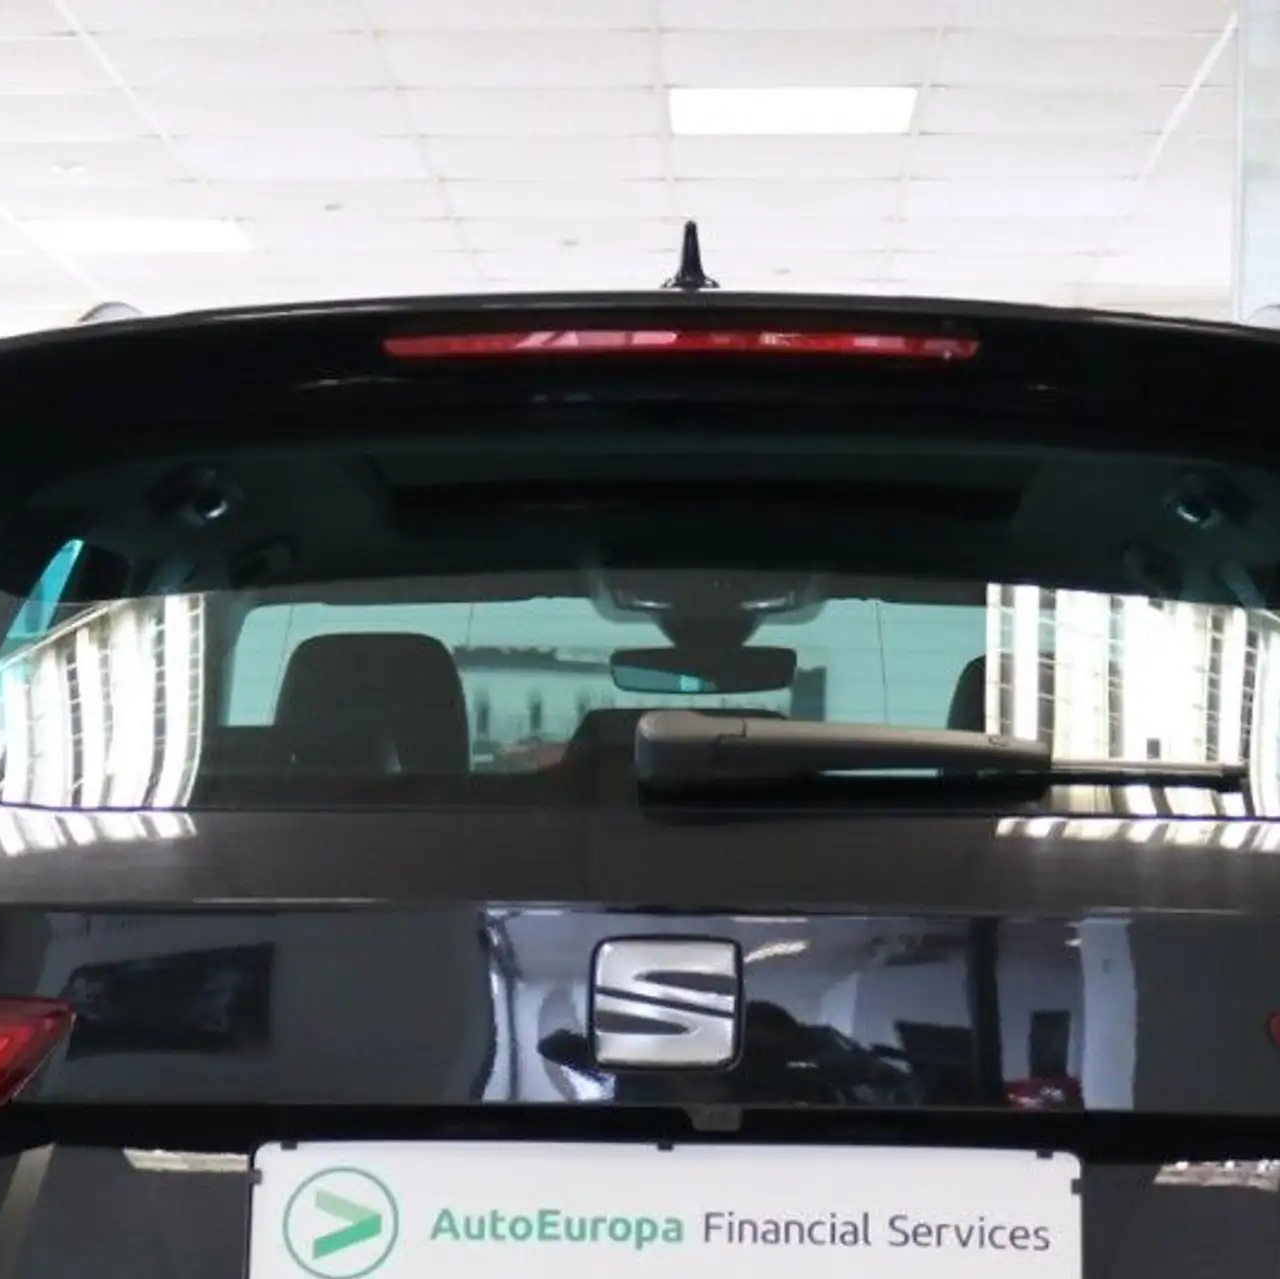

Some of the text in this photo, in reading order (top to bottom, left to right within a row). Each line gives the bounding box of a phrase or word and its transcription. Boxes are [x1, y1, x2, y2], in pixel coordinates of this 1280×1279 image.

[429, 1207, 1052, 1252] AutoEuropa Financial Services
